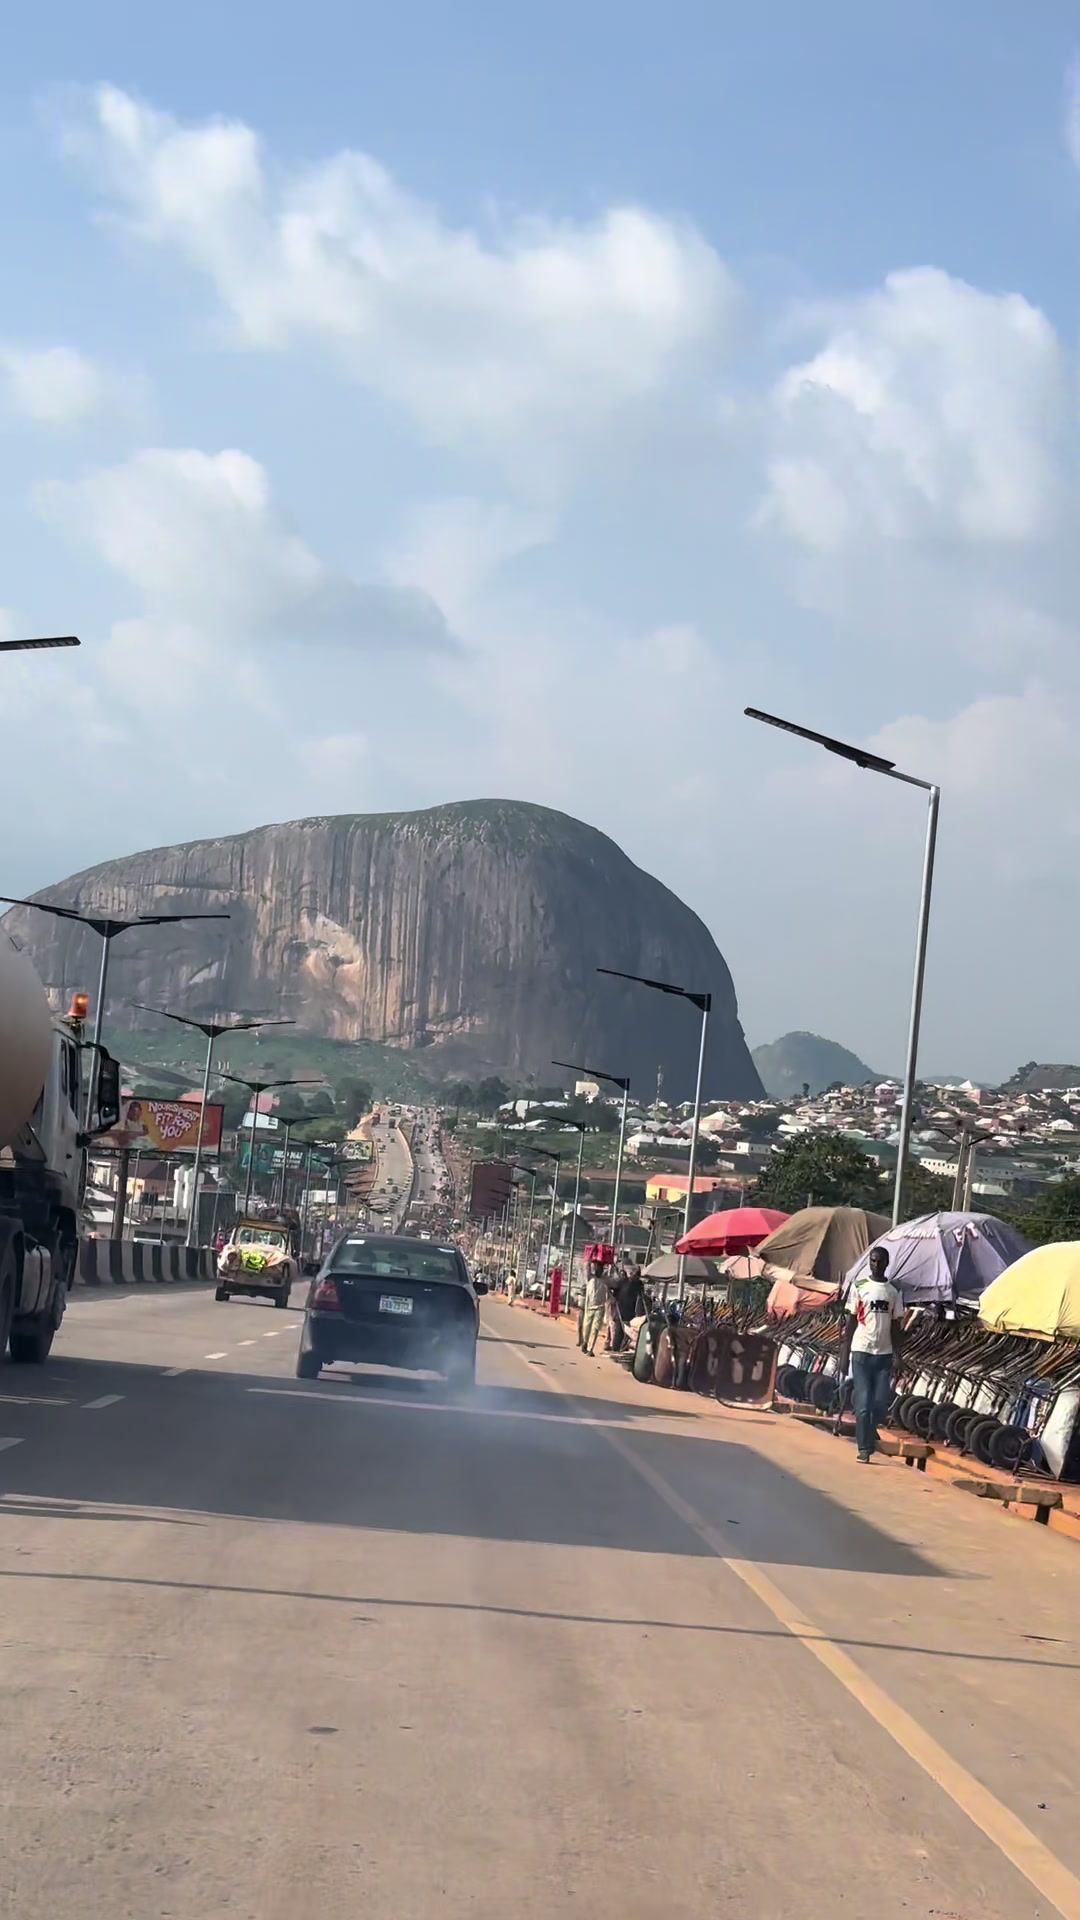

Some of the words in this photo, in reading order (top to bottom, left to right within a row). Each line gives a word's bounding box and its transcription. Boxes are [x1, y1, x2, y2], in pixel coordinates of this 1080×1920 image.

[154, 1112, 173, 1126] FIT
[172, 1115, 191, 1132] FOR
[159, 1124, 183, 1140] YOU
